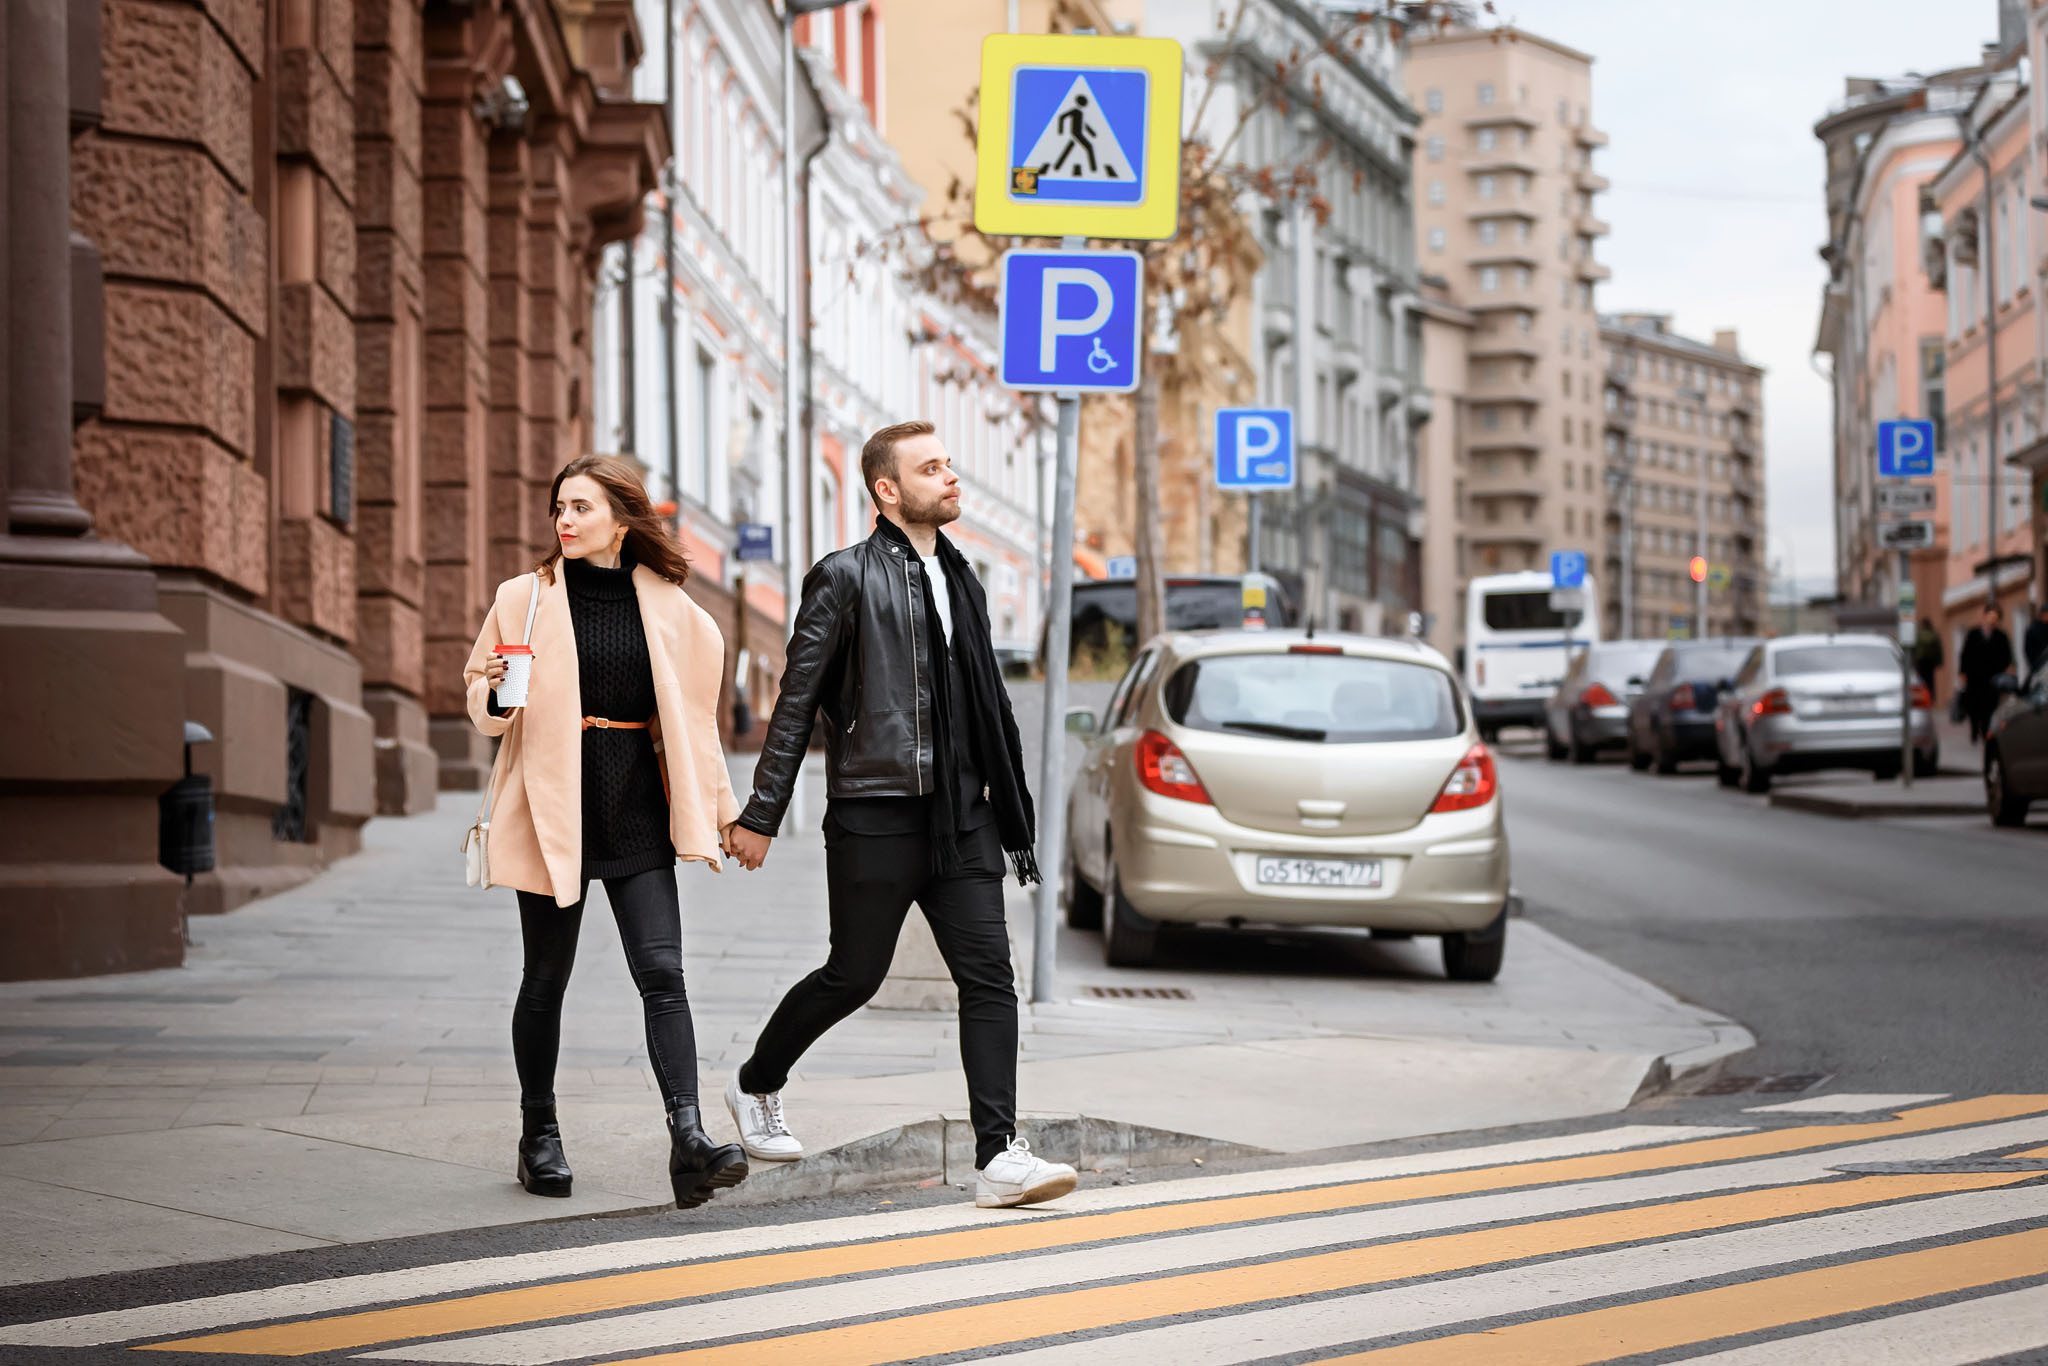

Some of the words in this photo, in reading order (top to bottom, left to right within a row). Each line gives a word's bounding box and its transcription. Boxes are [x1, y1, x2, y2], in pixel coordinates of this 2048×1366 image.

[1040, 267, 1114, 373] P
[1236, 417, 1280, 478] P
[1893, 426, 1924, 470] P
[1559, 553, 1580, 585] P
